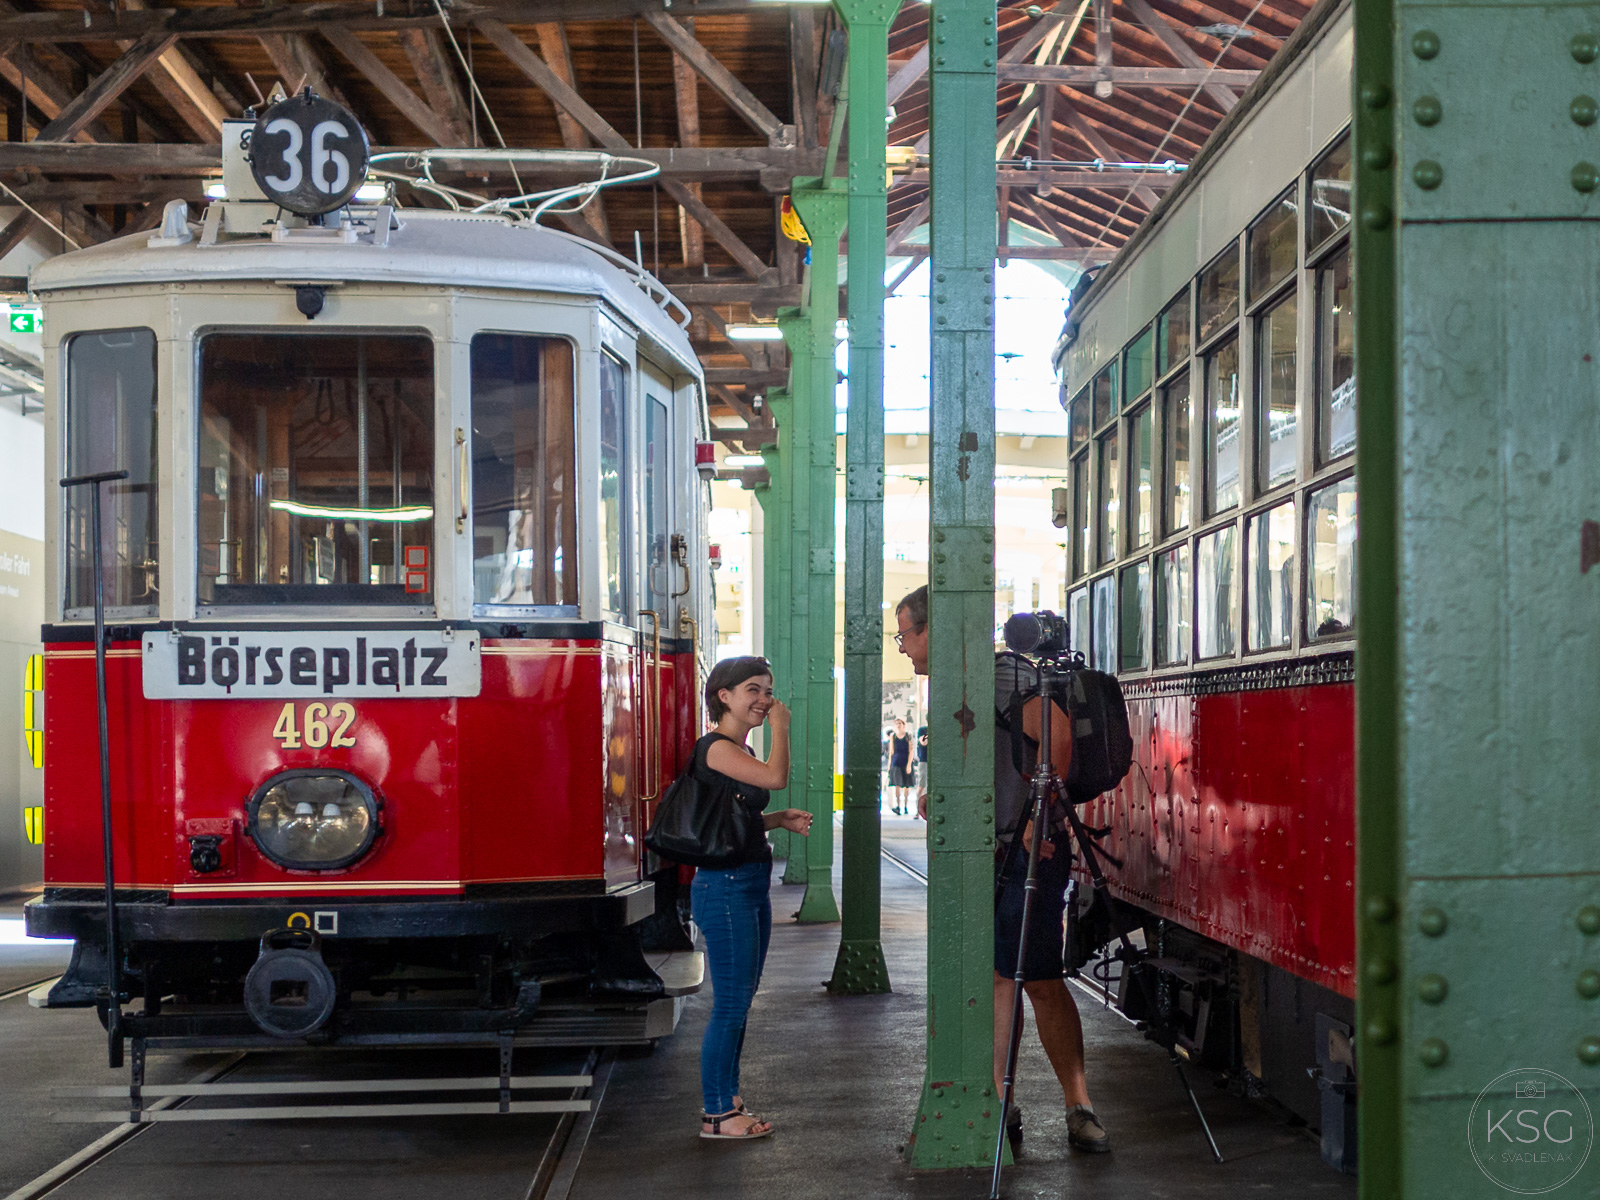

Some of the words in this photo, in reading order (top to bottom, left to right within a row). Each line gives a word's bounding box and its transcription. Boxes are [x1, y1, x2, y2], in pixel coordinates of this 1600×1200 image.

[264, 118, 350, 194] 36
[178, 636, 448, 694] Börseplatz
[273, 702, 356, 749] 462
